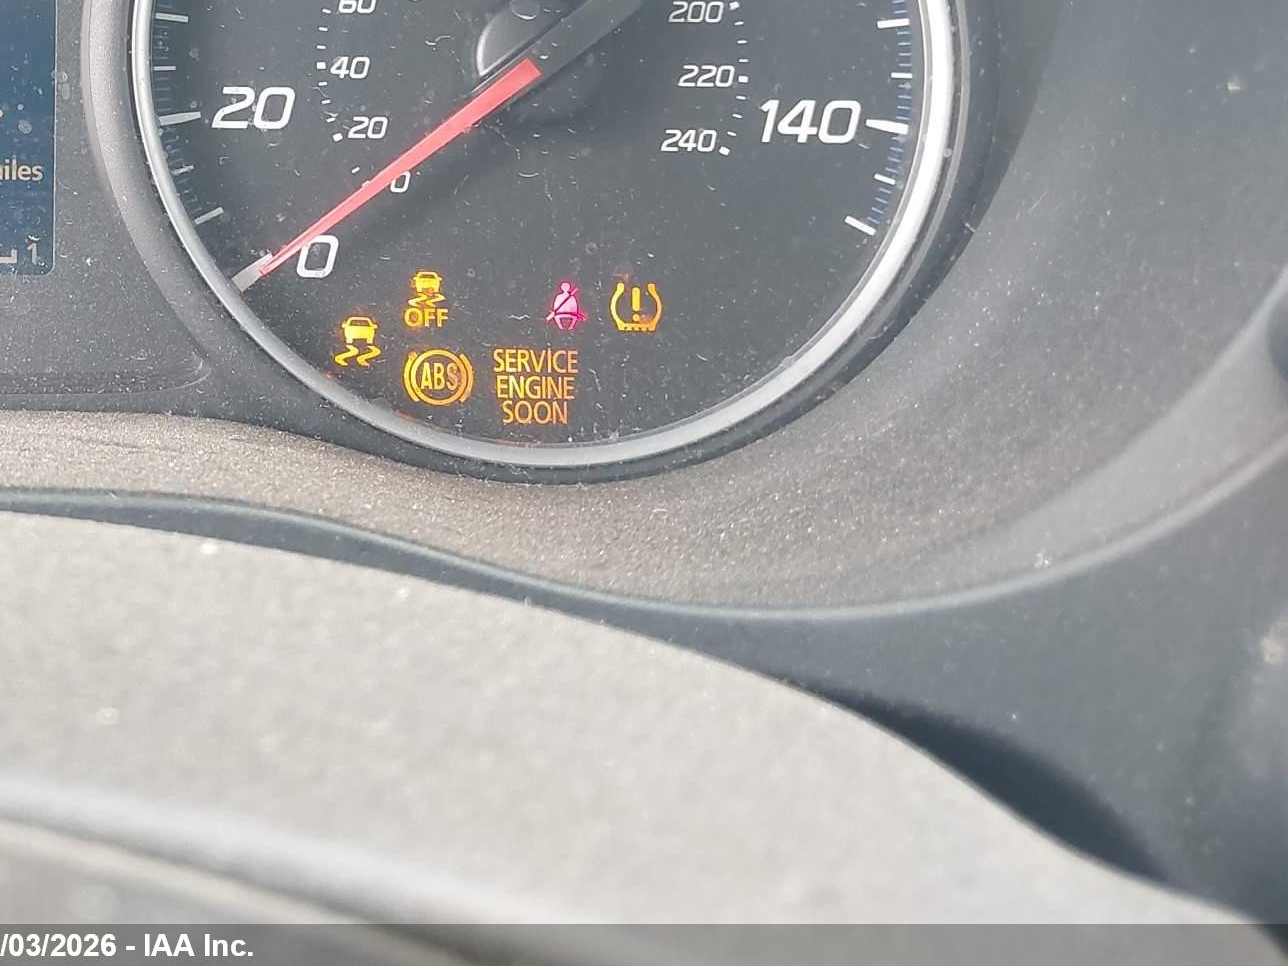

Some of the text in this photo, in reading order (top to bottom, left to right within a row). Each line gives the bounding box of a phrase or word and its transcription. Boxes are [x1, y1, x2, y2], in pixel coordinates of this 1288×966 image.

[669, 1, 724, 24] 200
[330, 57, 370, 80] 40
[678, 66, 735, 88] 220
[212, 87, 295, 130] 20
[347, 116, 389, 139] 20
[758, 99, 862, 144] 140
[660, 129, 717, 152] 240
[390, 171, 411, 192] 0
[26, 242, 39, 266] 1
[296, 235, 338, 278] 0
[404, 308, 448, 328] OFF
[494, 349, 578, 373] SERVICE
[420, 362, 457, 390] ABS
[496, 375, 574, 400] ENGINE
[502, 401, 567, 424] SOON
